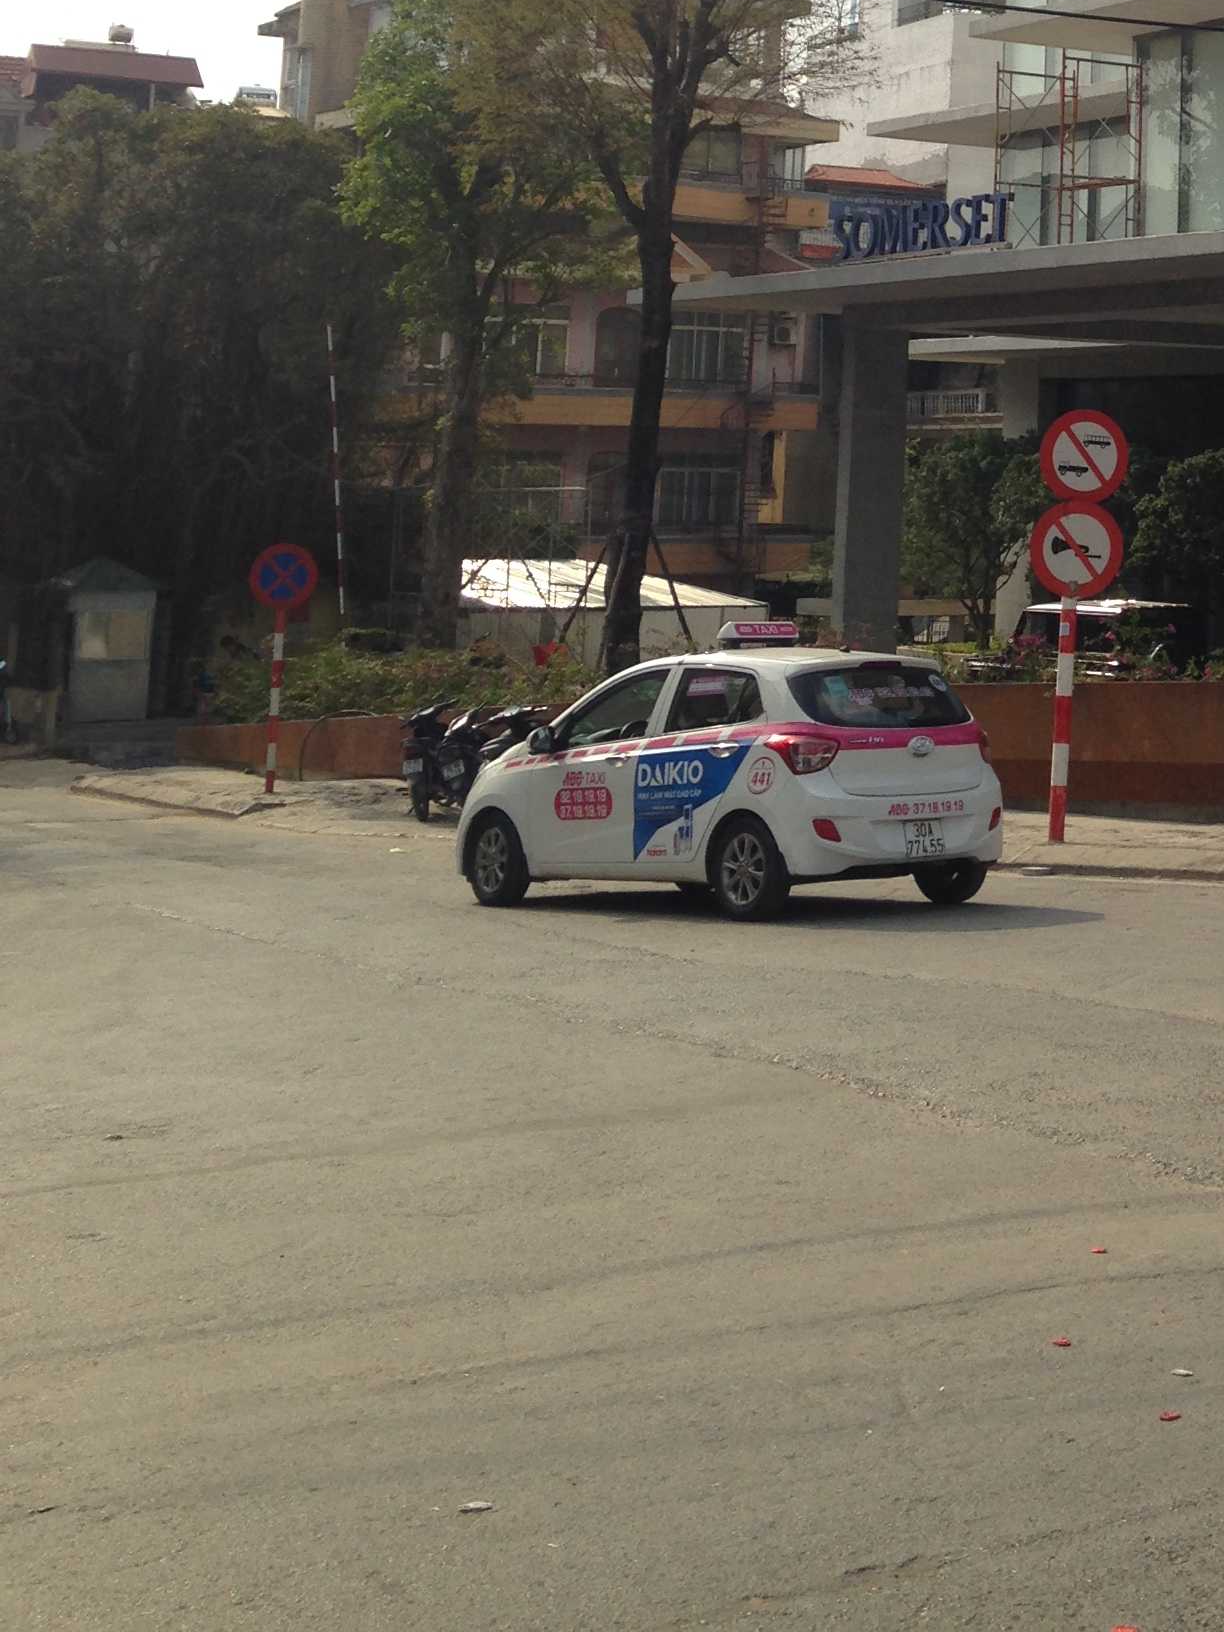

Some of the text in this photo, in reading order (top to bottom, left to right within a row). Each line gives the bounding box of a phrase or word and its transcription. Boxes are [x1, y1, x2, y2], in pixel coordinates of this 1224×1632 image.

[832, 191, 1013, 263] SOMERSET
[752, 624, 778, 634] TAXI
[638, 760, 703, 786] DAIKIO
[752, 771, 771, 785] 441
[912, 823, 933, 838] 30A
